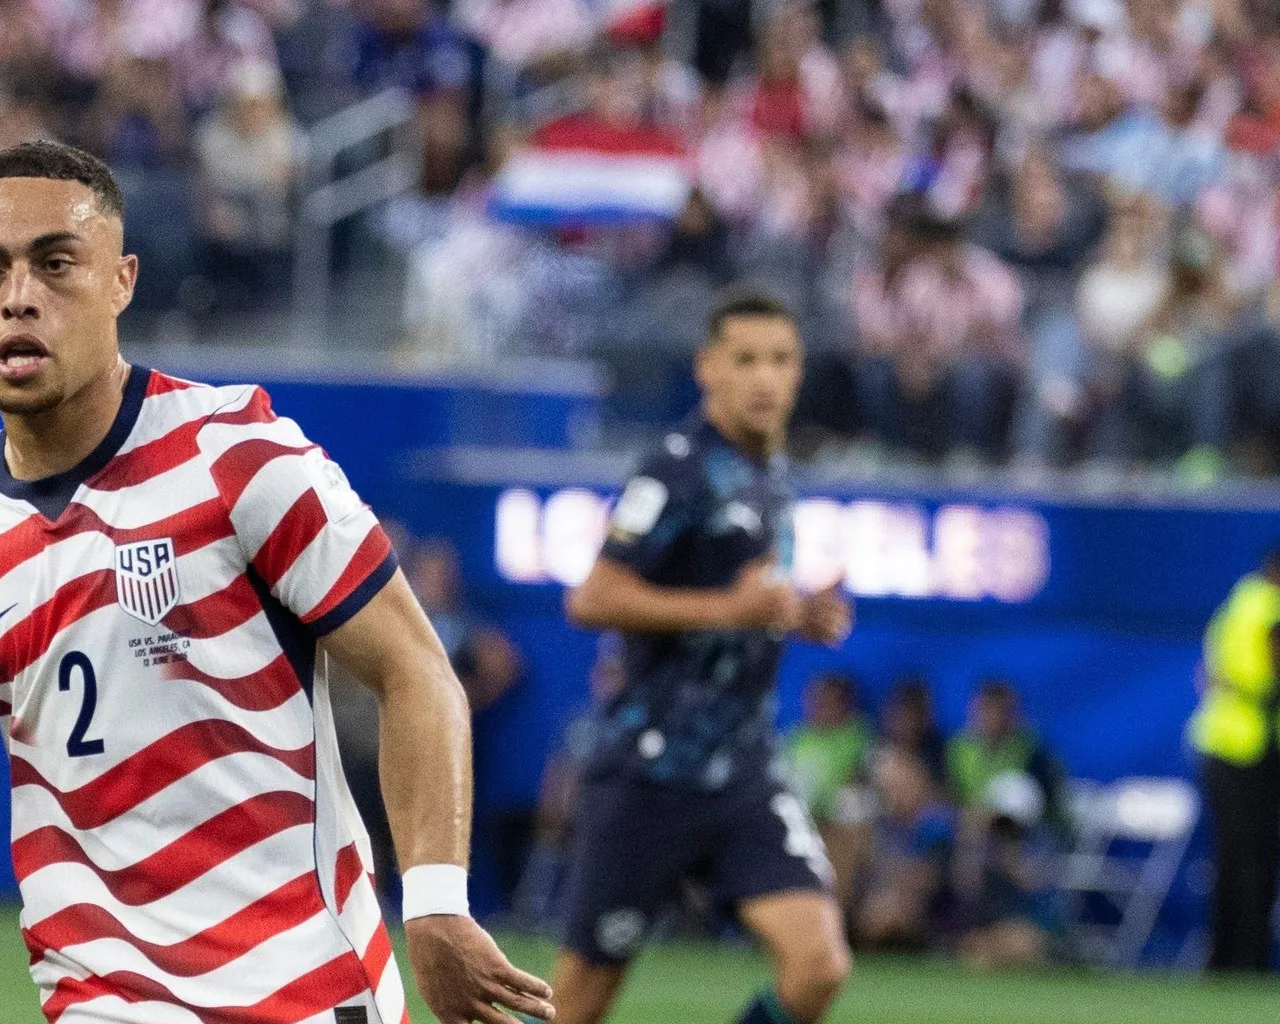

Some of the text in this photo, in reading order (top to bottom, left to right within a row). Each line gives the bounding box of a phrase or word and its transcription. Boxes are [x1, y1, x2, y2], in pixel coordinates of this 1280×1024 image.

[120, 543, 170, 577] USA
[128, 638, 141, 648] USA
[134, 648, 147, 658] LOS
[182, 639, 191, 649] CA
[58, 651, 105, 758] 2
